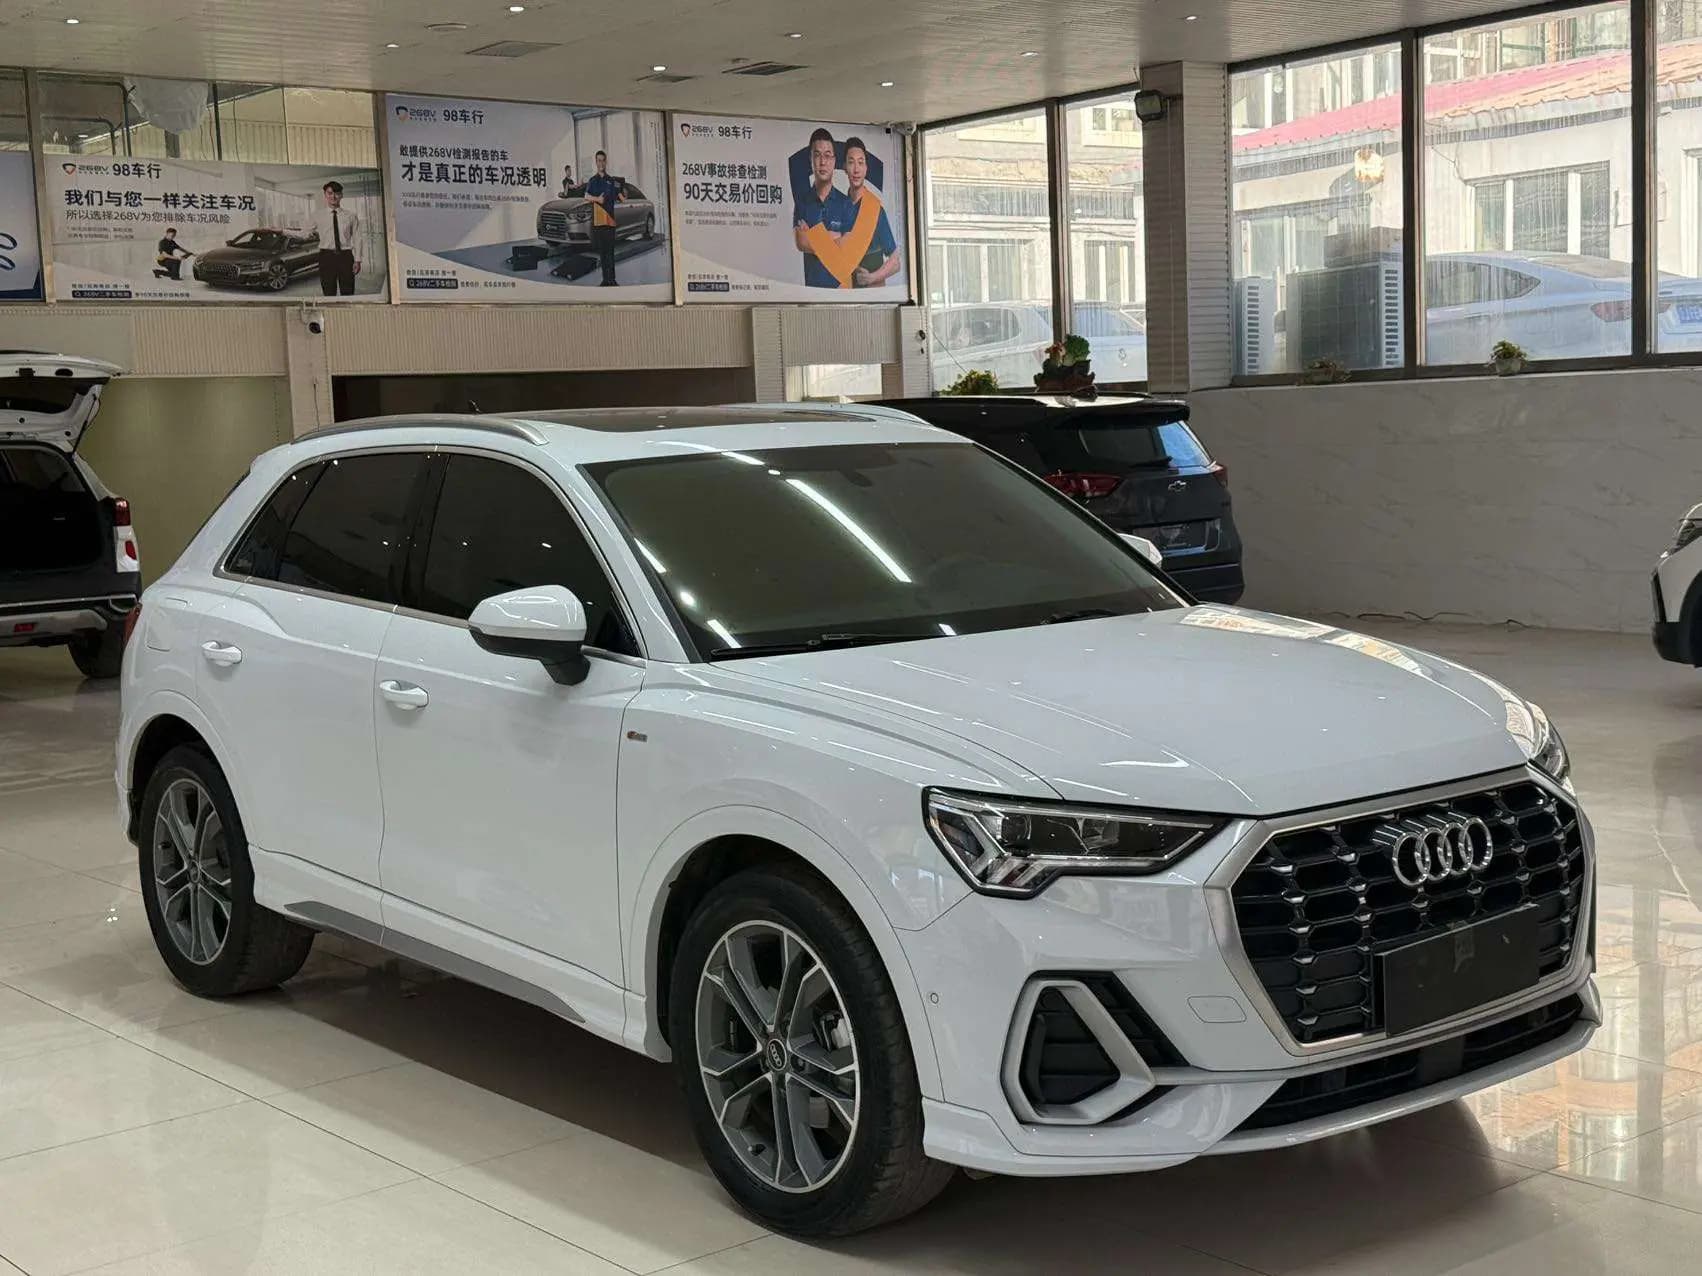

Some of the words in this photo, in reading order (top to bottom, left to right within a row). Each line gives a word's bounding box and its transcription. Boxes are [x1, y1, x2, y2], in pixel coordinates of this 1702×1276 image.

[443, 109, 484, 125] 98车行
[718, 125, 752, 139] 98车行
[112, 162, 162, 179] 98车行
[401, 161, 547, 187] 才是真正的车况透明
[682, 162, 767, 180] 268V事故排查检测
[64, 189, 256, 211] 我们与您一样关注车况
[683, 182, 783, 205] 90天交易价回购
[66, 209, 231, 224] 所以选择268V为您排除车况风险
